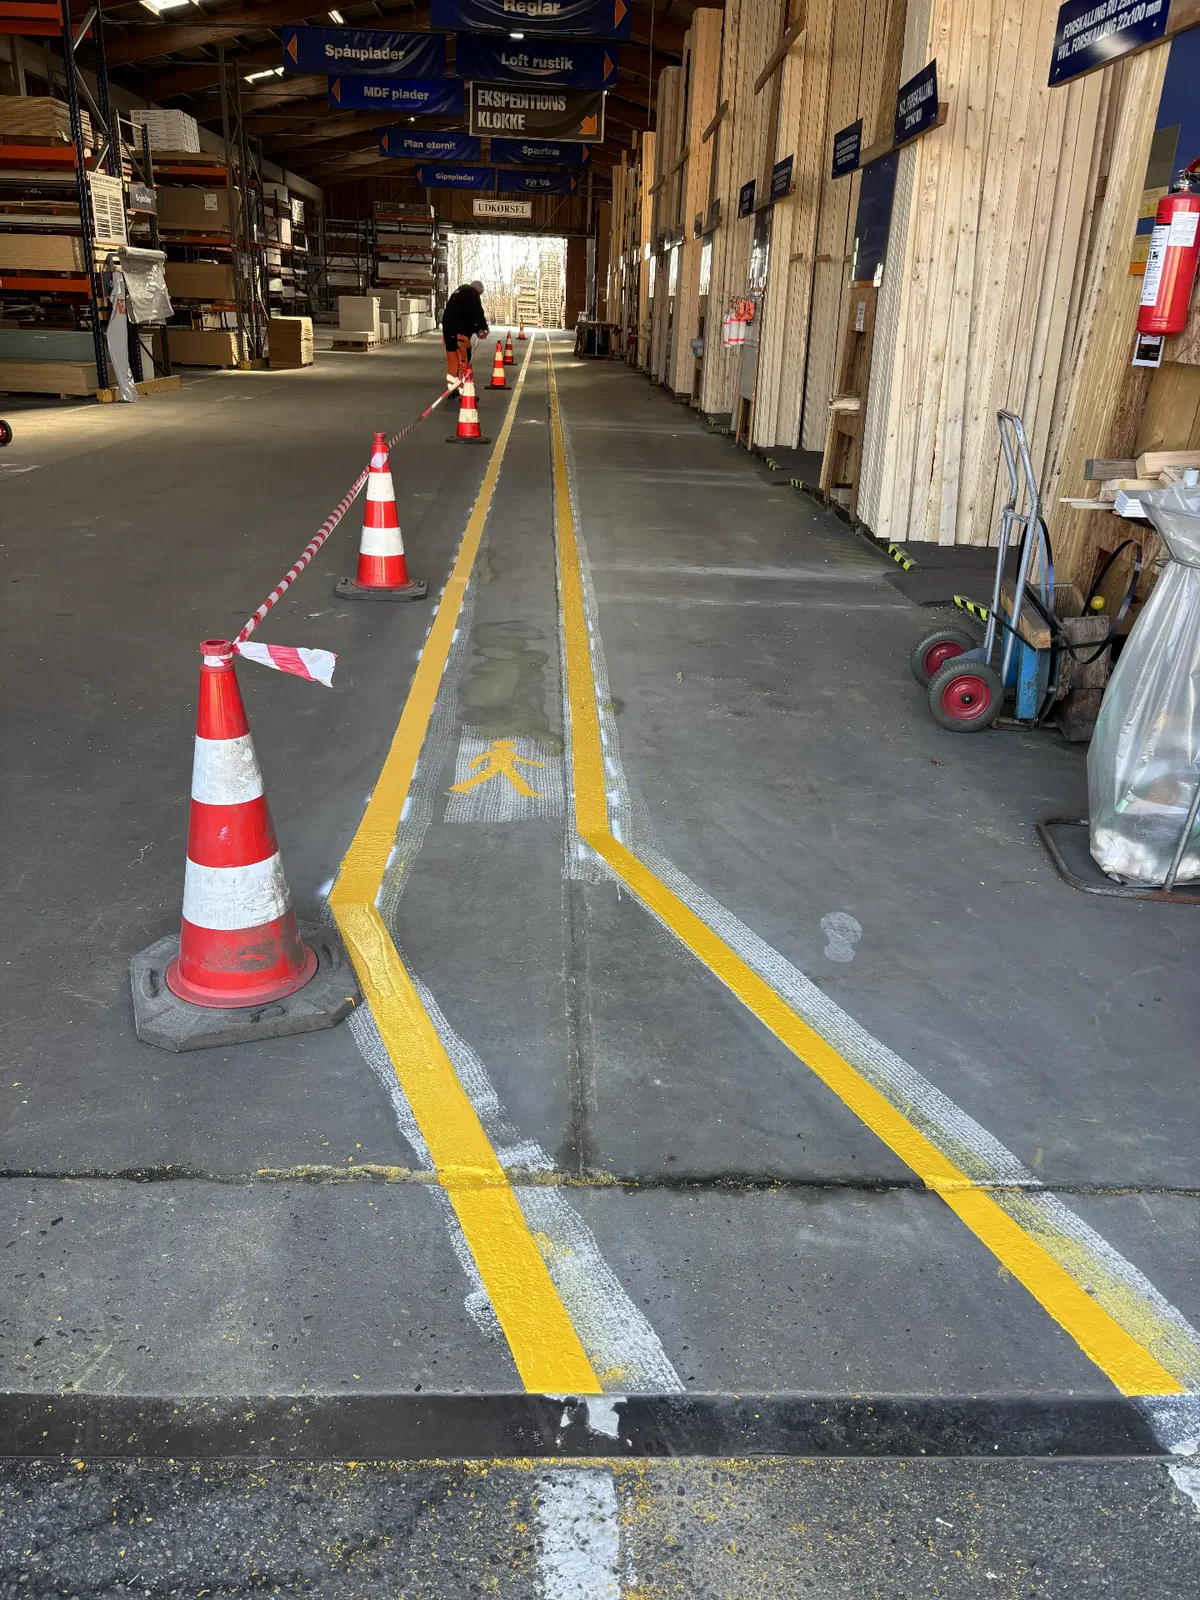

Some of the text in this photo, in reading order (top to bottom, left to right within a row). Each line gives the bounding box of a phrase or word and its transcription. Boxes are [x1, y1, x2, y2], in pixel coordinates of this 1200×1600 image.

[504, 0, 561, 16] Reglar
[1063, 3, 1107, 40] FORSKALLING
[1071, 17, 1117, 53] FORSKALLING
[1116, 2, 1146, 31] 22x100
[1145, 0, 1162, 18] mm
[325, 44, 405, 61] Spånplader
[501, 53, 573, 70] Loft rustik
[363, 86, 430, 100] MDF plader
[478, 90, 566, 111] EKSPEDITIONS
[478, 112, 525, 130] KLOKKE
[404, 139, 456, 151] Plan eternit
[522, 146, 560, 156] Spærtræ
[435, 173, 475, 182] Gipsplader
[478, 203, 528, 214] UDKØRSEL
